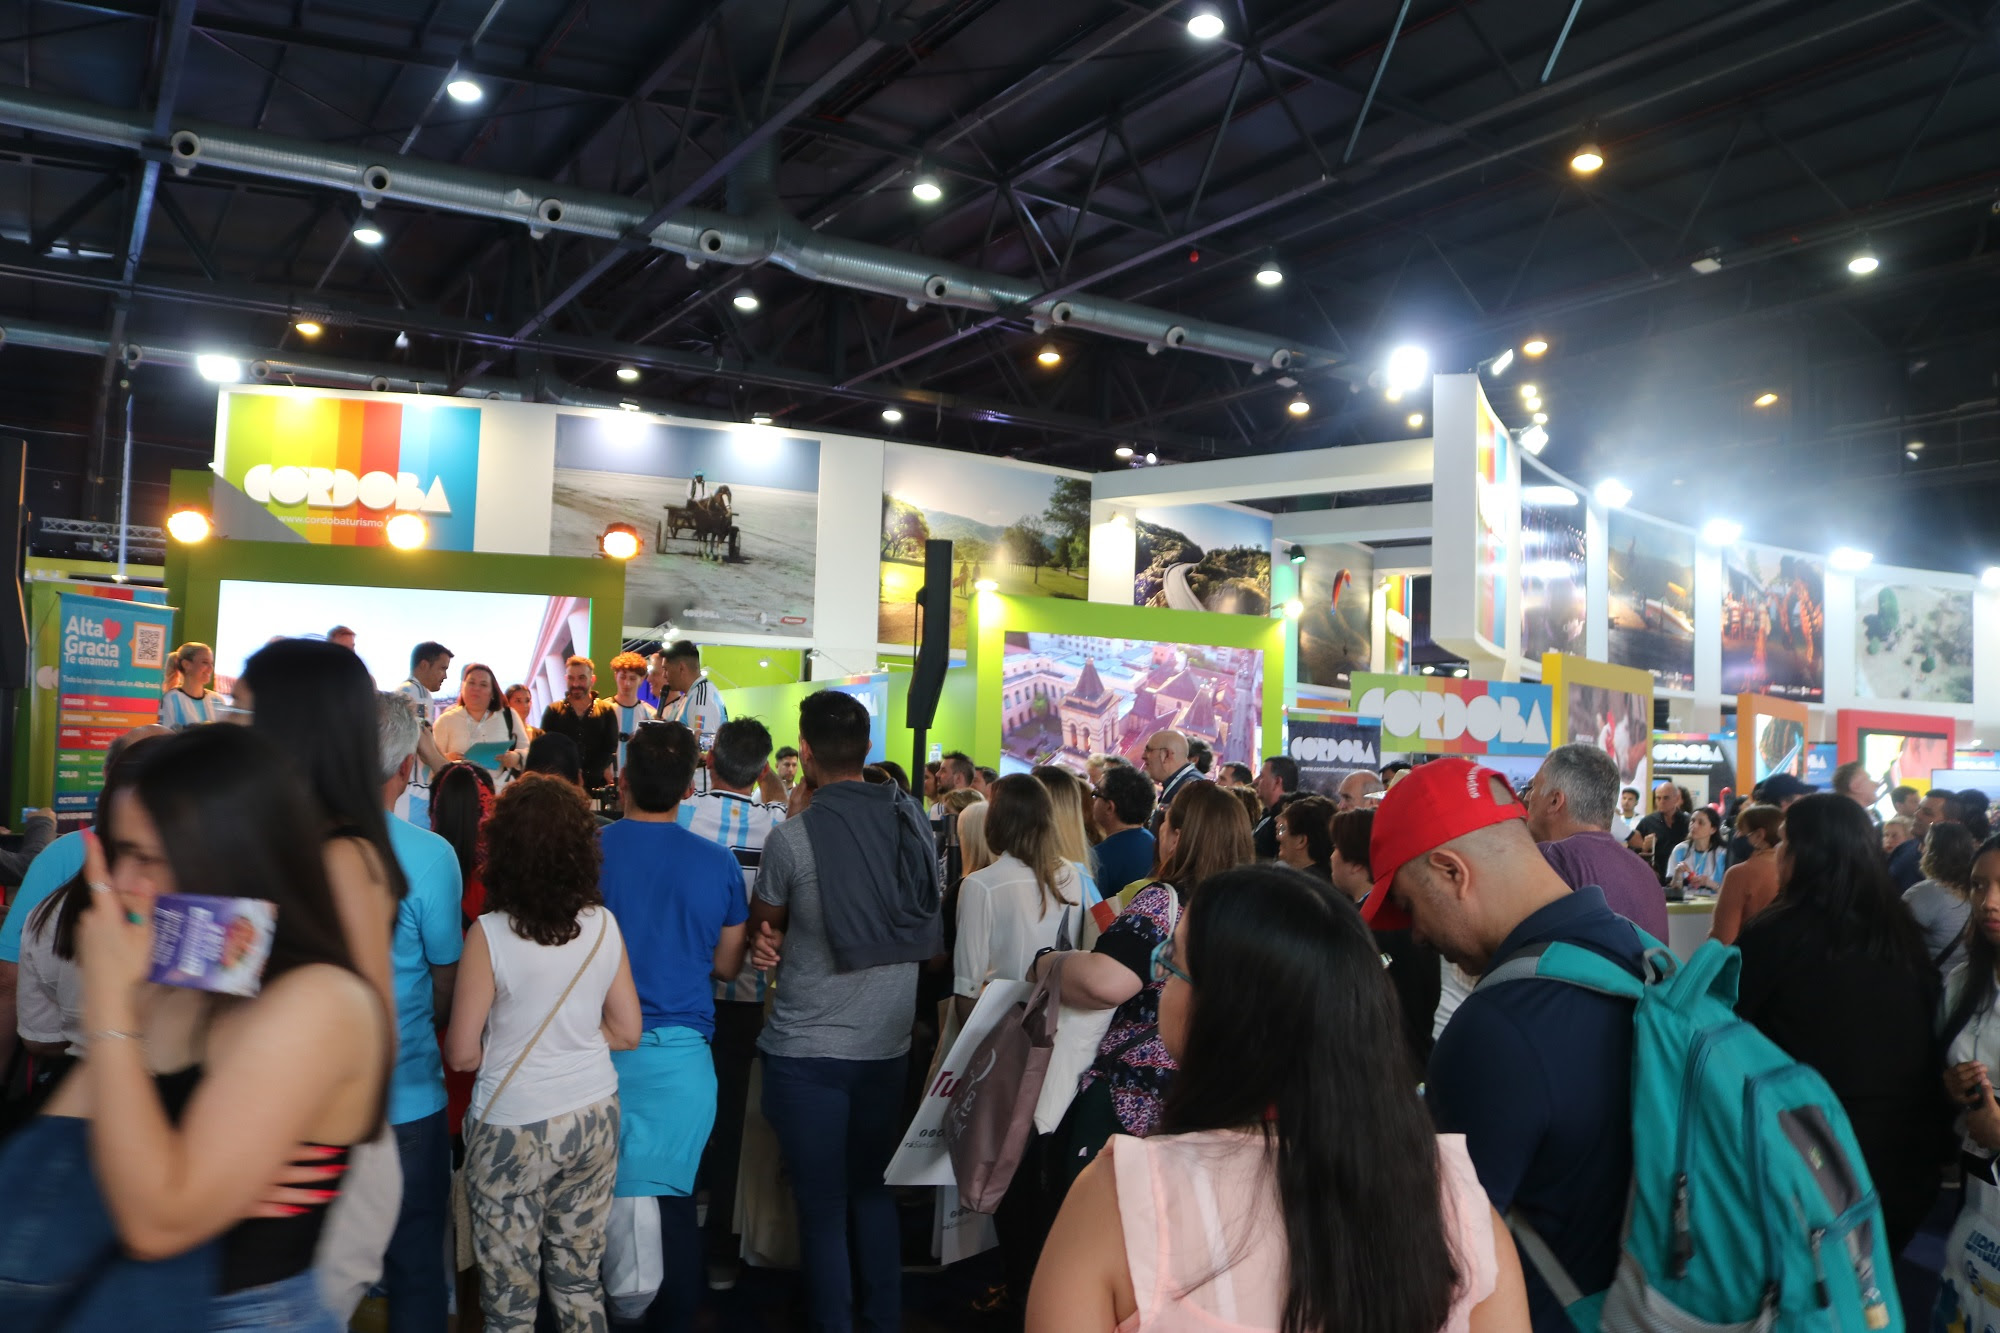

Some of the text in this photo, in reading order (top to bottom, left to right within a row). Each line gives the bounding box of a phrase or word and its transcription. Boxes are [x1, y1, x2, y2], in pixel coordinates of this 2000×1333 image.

[277, 514, 384, 528] www.cordobaturismo
[65, 615, 104, 637] Alta
[64, 634, 119, 658] Gracia
[64, 652, 119, 668] Te enamora
[1652, 744, 1724, 762] ORDOBA
